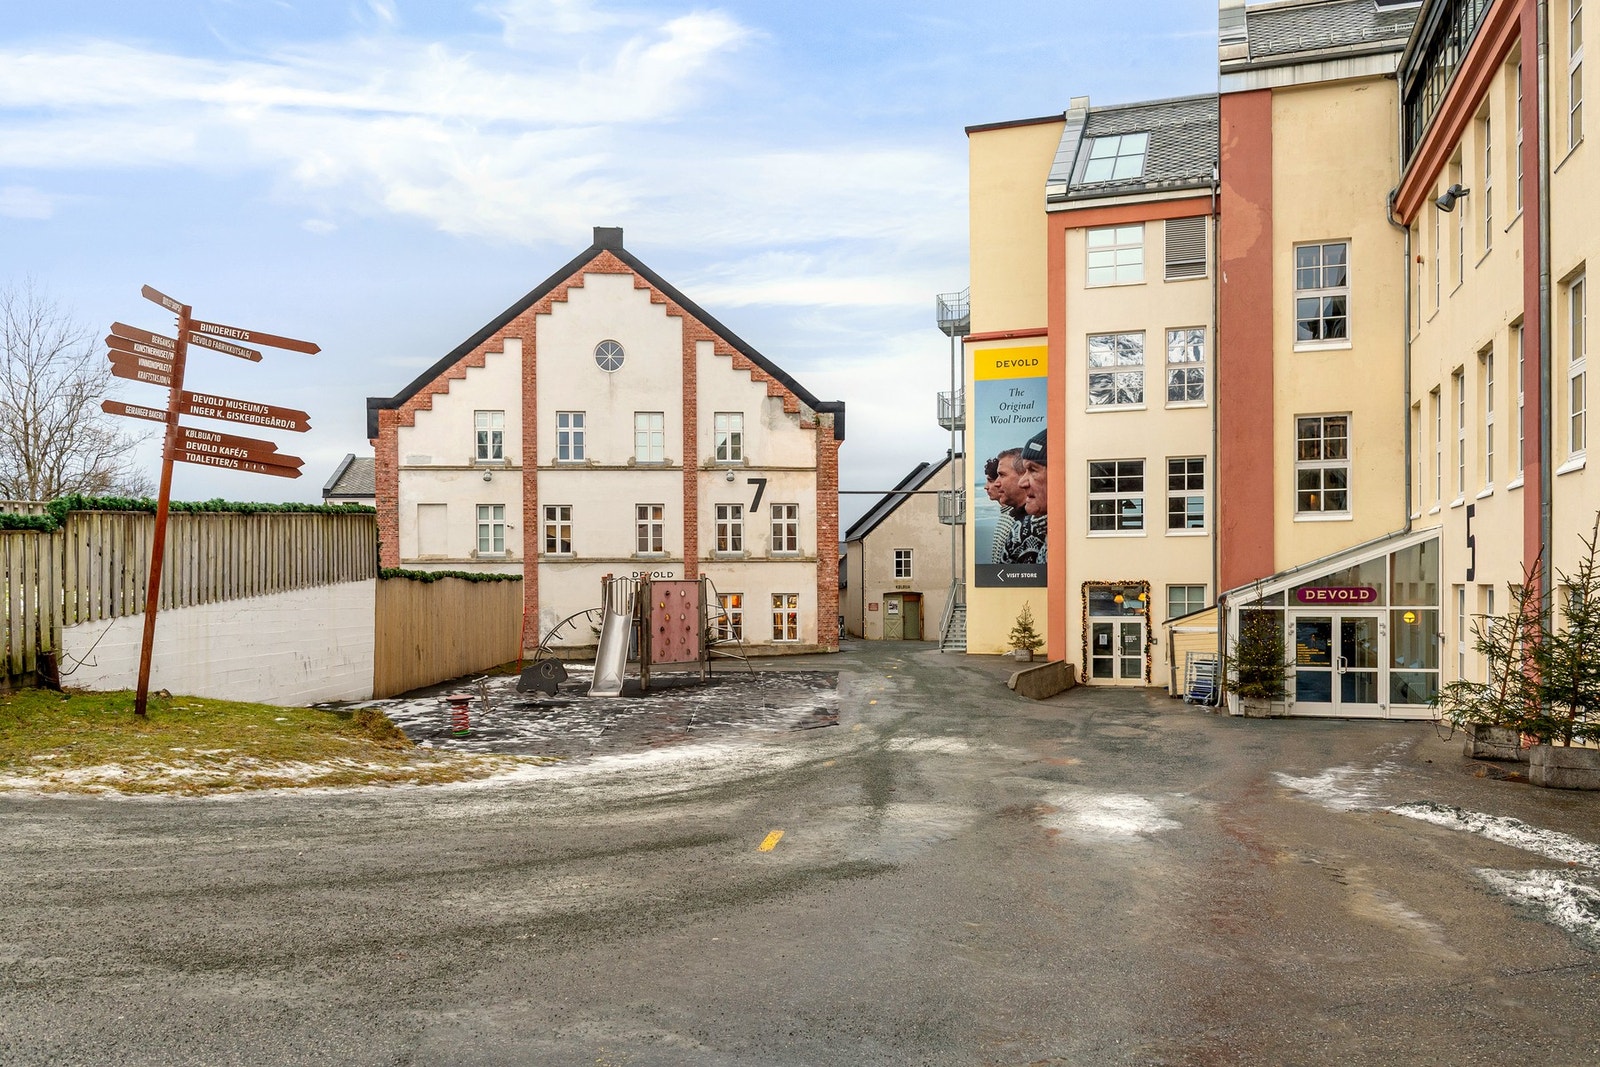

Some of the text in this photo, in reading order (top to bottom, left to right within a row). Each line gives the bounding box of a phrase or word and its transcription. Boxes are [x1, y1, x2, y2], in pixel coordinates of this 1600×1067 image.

[200, 323, 250, 340] BINDERIET/5
[192, 334, 212, 347] DEVOLD
[996, 359, 1038, 368] DEVOLD
[1009, 388, 1025, 397] The
[192, 394, 269, 414] DEVOLD MUSEUM/5
[999, 400, 1035, 413] Original
[190, 405, 215, 416] INGER
[216, 410, 224, 418] K.
[990, 415, 1044, 424] Wool Pioneer
[185, 429, 221, 442] KØLBUA/10
[186, 441, 248, 458] DEVOLD KAFÉ/5
[186, 453, 238, 468] TOALETTER/5
[747, 478, 767, 512] 7
[1466, 504, 1475, 581] 5
[1306, 590, 1369, 599] DEVOLD
